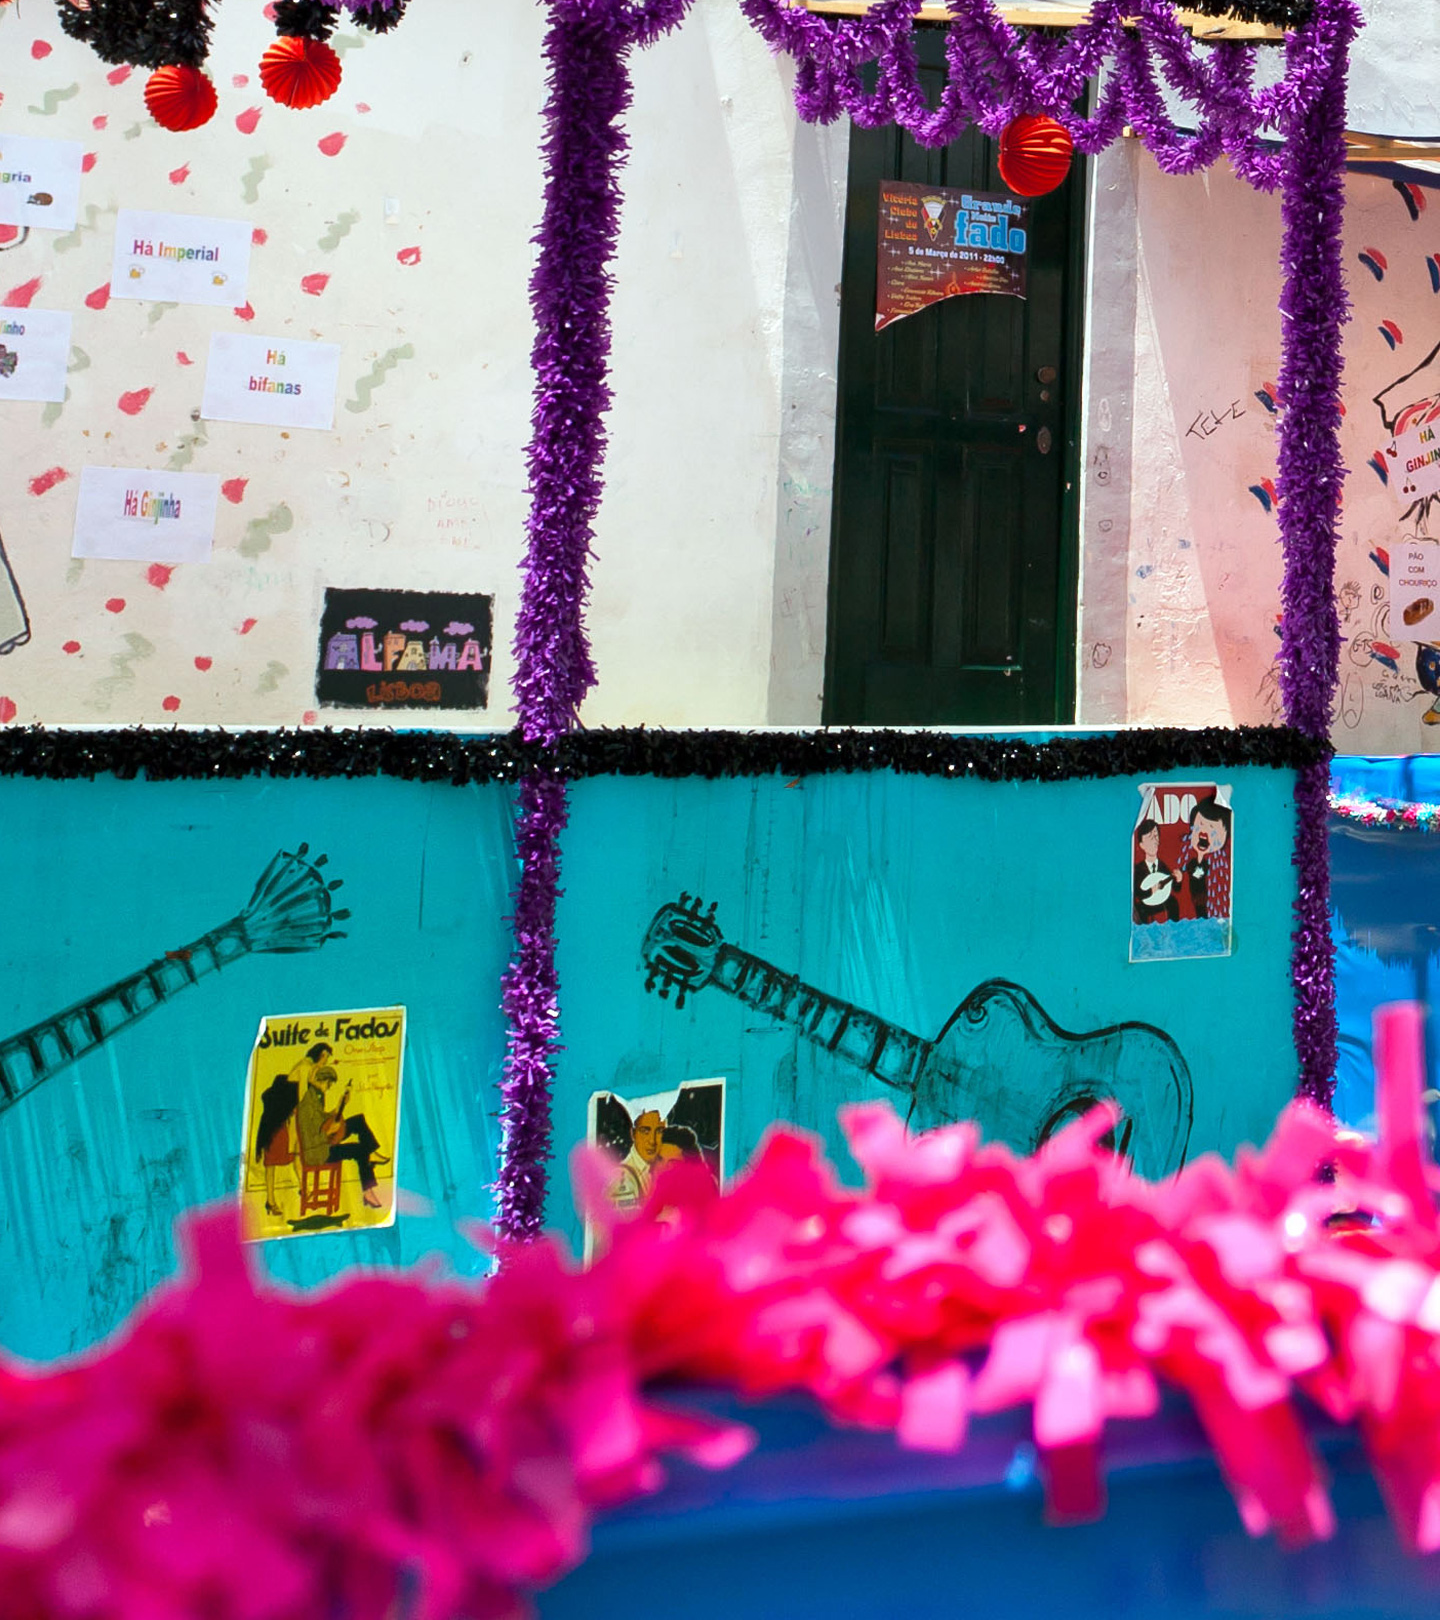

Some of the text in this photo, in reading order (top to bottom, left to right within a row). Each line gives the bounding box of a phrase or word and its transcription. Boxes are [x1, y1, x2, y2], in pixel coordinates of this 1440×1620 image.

[954, 209, 1026, 254] fado
[133, 239, 219, 262] Há Imperial
[959, 251, 978, 261] 2011
[266, 349, 286, 367] Há
[248, 375, 302, 396] bifanas
[123, 489, 182, 525] Há Ginjinha
[1408, 552, 1424, 561] PÃO
[1408, 566, 1425, 574] COM
[1398, 578, 1438, 588] CHOURIÇO
[323, 630, 483, 672] ALFAMA
[1146, 793, 1198, 825] ADO
[258, 1016, 400, 1049] Suite de Fados
